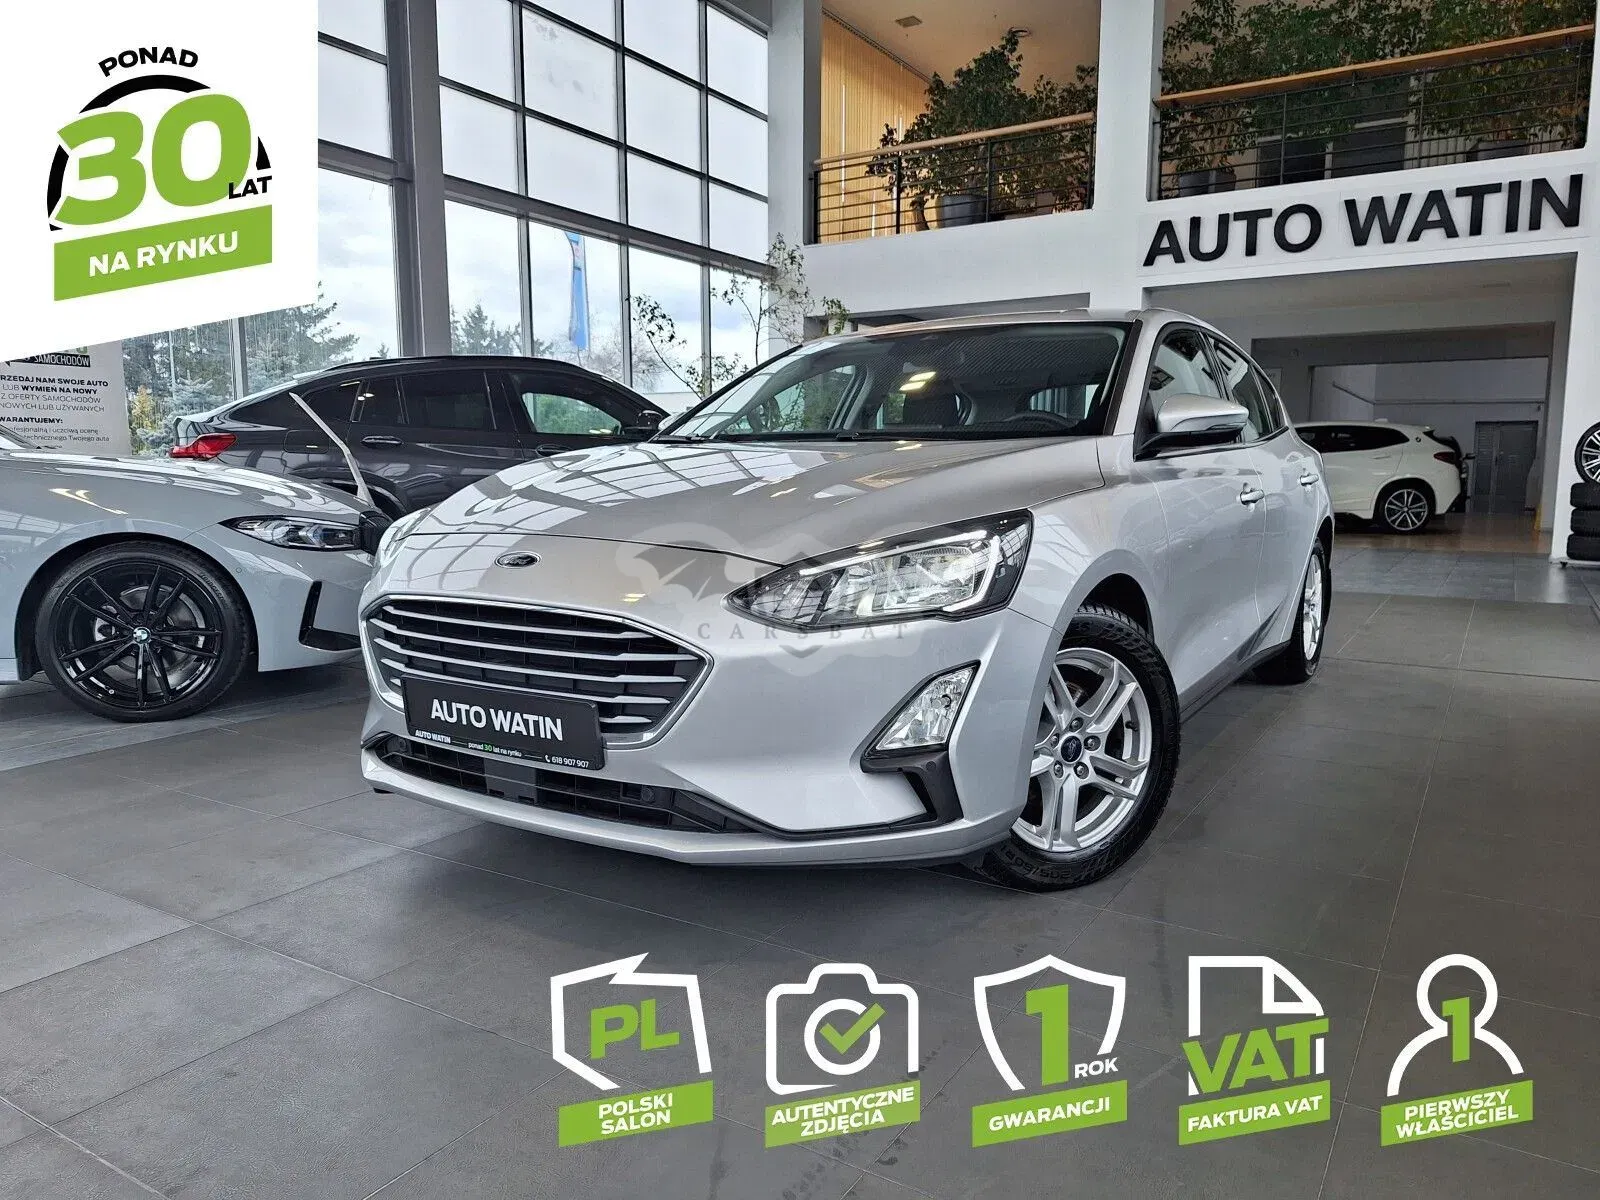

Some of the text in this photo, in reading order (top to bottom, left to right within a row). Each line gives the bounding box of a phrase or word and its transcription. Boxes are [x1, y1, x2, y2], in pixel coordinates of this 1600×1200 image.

[1143, 174, 1584, 267] AUTO WATIN
[34, 354, 89, 366] SAMOCHODÓW
[36, 376, 55, 384] NAM
[41, 394, 101, 403] SAMOCHODÓW
[431, 698, 563, 741] AUTO WATIN
[415, 729, 451, 744] AUTO WATIN
[483, 744, 492, 752] 30
[552, 756, 589, 768] 618 907 907
